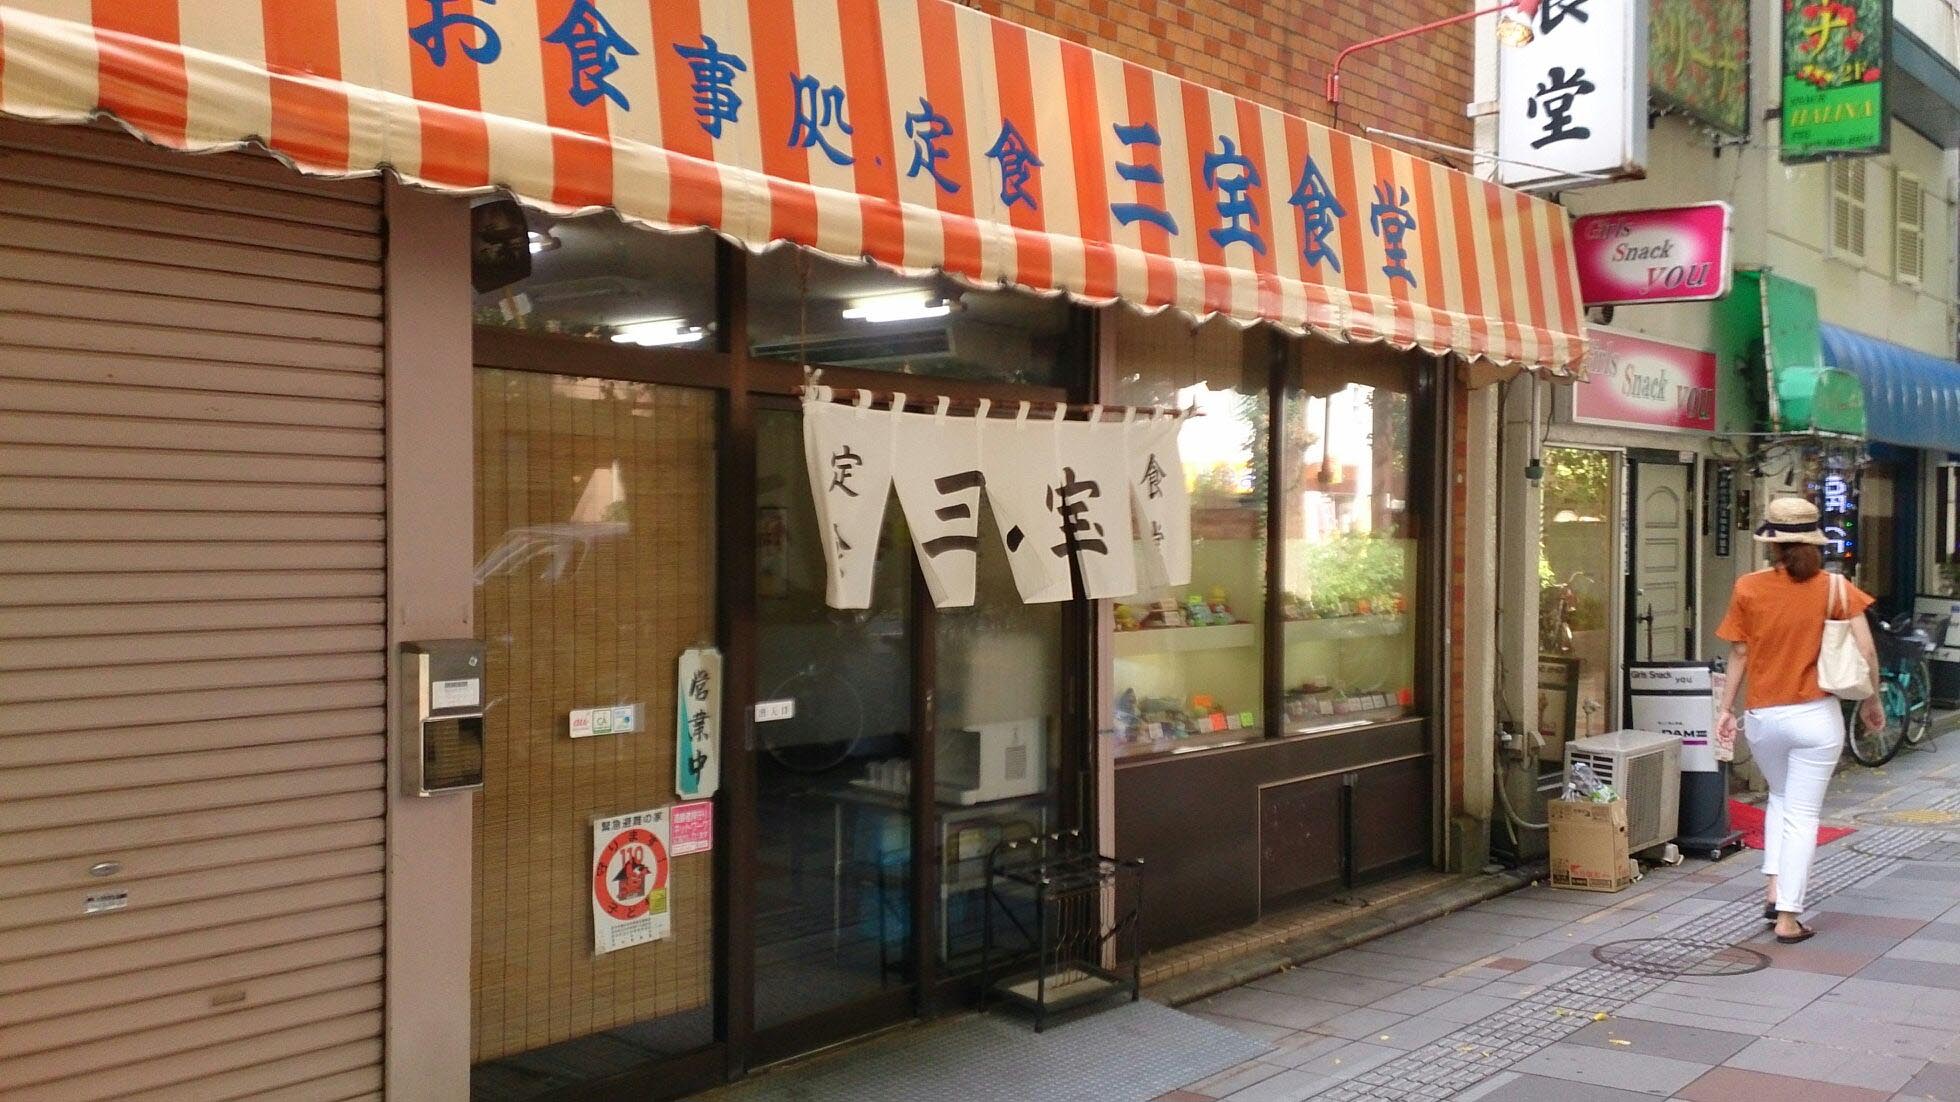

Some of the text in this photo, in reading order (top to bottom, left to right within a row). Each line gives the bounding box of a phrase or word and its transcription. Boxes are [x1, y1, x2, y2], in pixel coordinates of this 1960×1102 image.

[1110, 121, 1418, 289] 三宝食堂
[1612, 239, 1674, 262] Snack
[1622, 363, 1669, 401] Snack
[1649, 671, 1672, 680] Snack
[687, 668, 711, 787] 営業中
